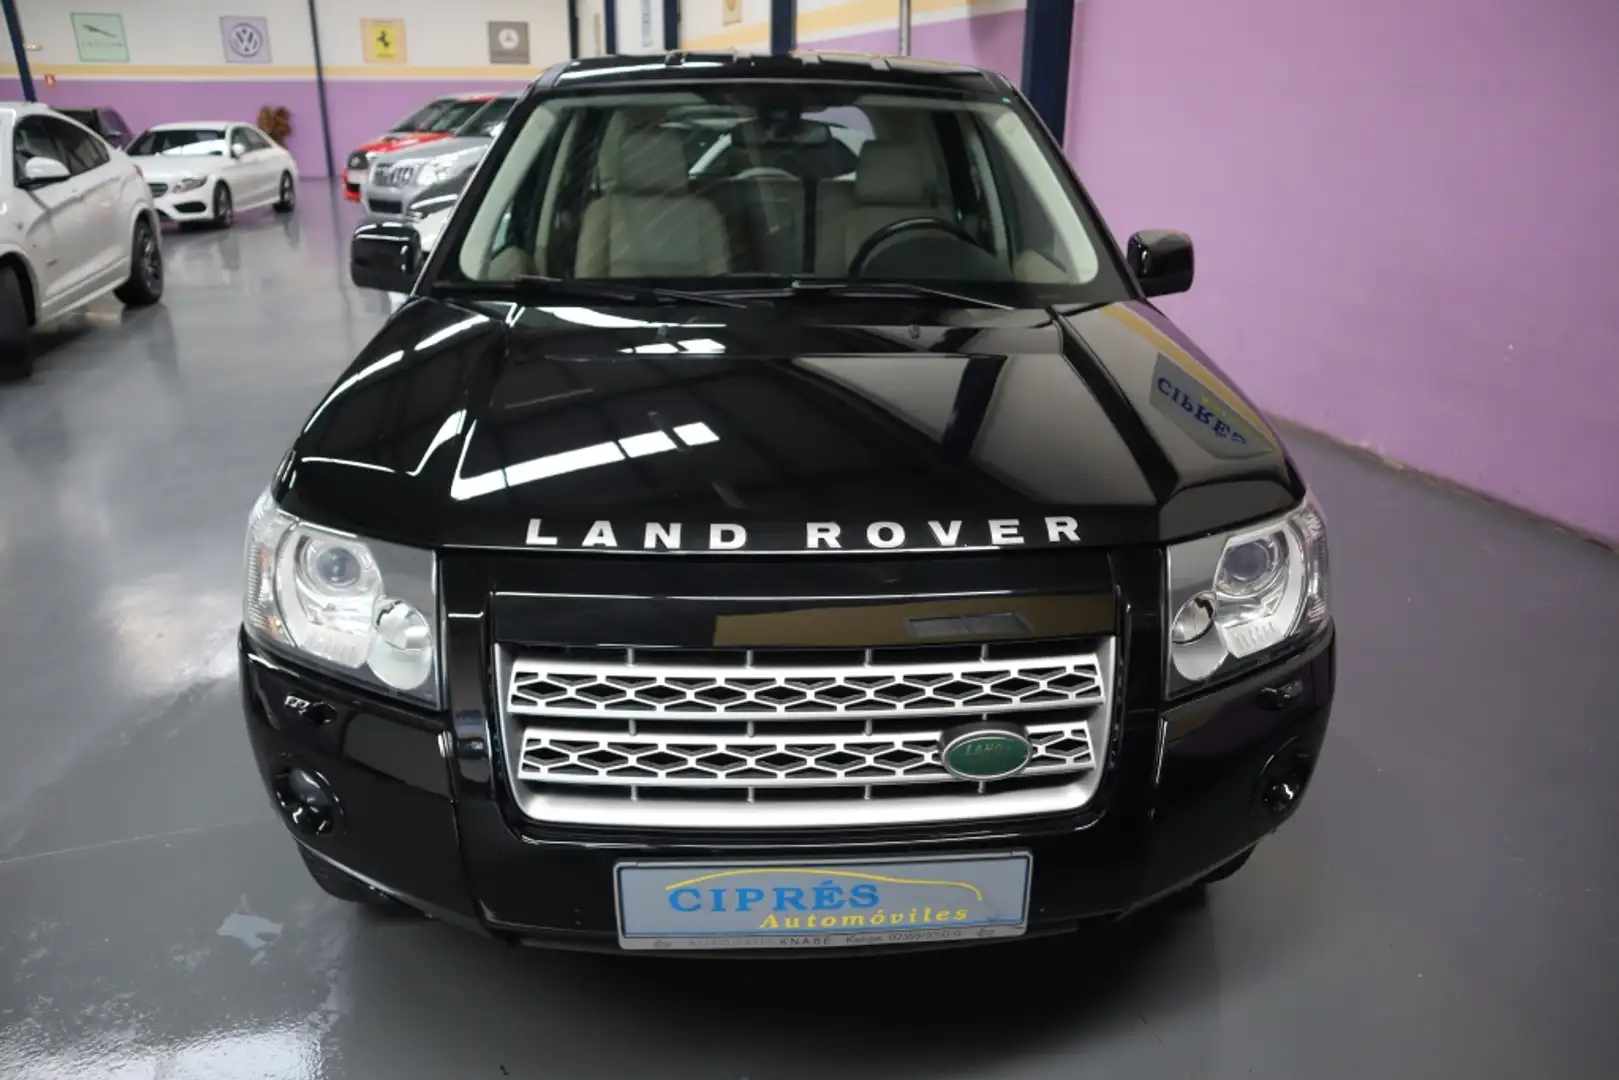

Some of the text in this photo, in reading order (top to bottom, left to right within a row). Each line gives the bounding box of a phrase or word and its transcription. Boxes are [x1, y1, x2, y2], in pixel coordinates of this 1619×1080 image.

[525, 516, 1081, 550] LAND ROVER
[668, 880, 879, 912] CIPRÉS
[759, 907, 969, 929] Automóviles
